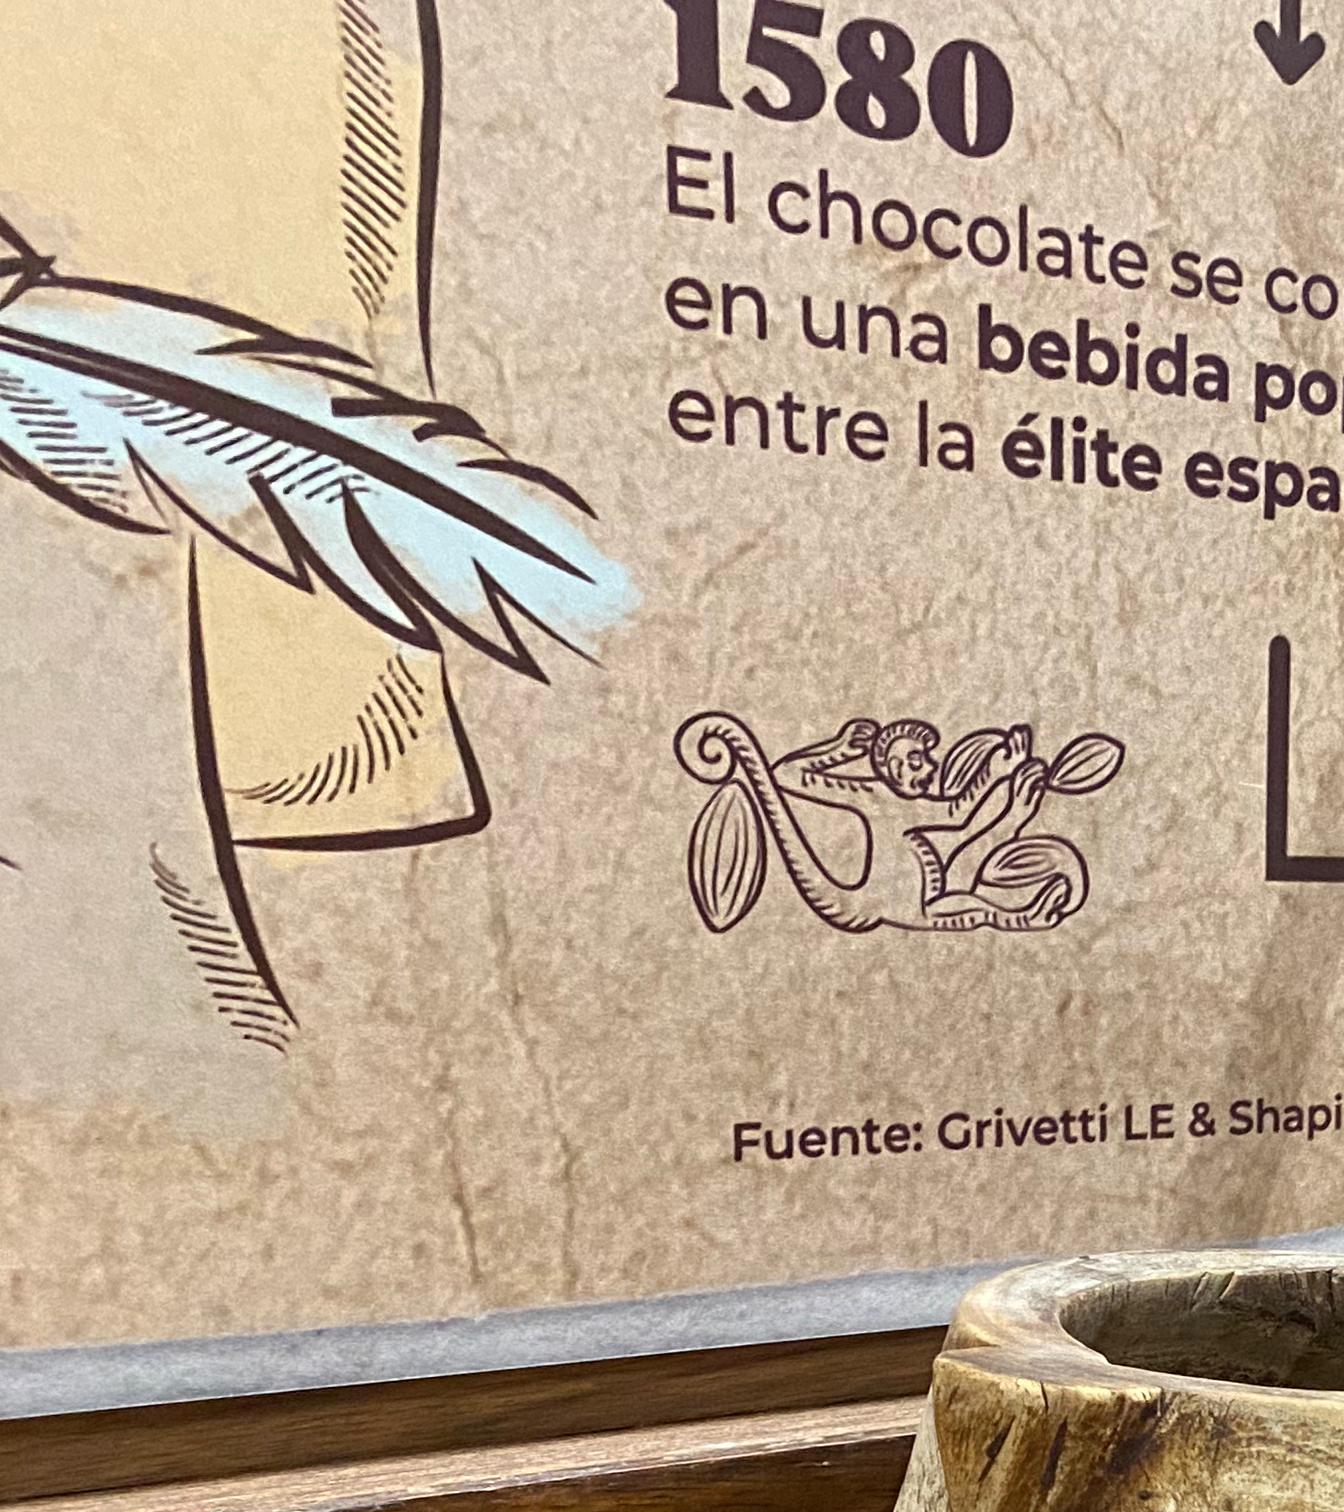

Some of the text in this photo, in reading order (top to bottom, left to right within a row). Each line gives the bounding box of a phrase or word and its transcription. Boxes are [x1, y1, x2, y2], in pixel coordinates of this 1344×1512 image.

[664, 0, 1013, 158] 1580
[667, 145, 735, 223] El
[768, 169, 1148, 289] chocolate
[1171, 251, 1242, 305] se
[665, 277, 767, 340] en
[802, 296, 947, 364] una
[979, 303, 1229, 402] bebida
[669, 390, 888, 461] entre
[919, 400, 974, 472] la
[1002, 413, 1162, 491] élite
[734, 1119, 922, 1162] Fuente:
[938, 1103, 1107, 1150] Grivetti
[1125, 1104, 1174, 1140] LE
[1189, 1102, 1216, 1137] &
